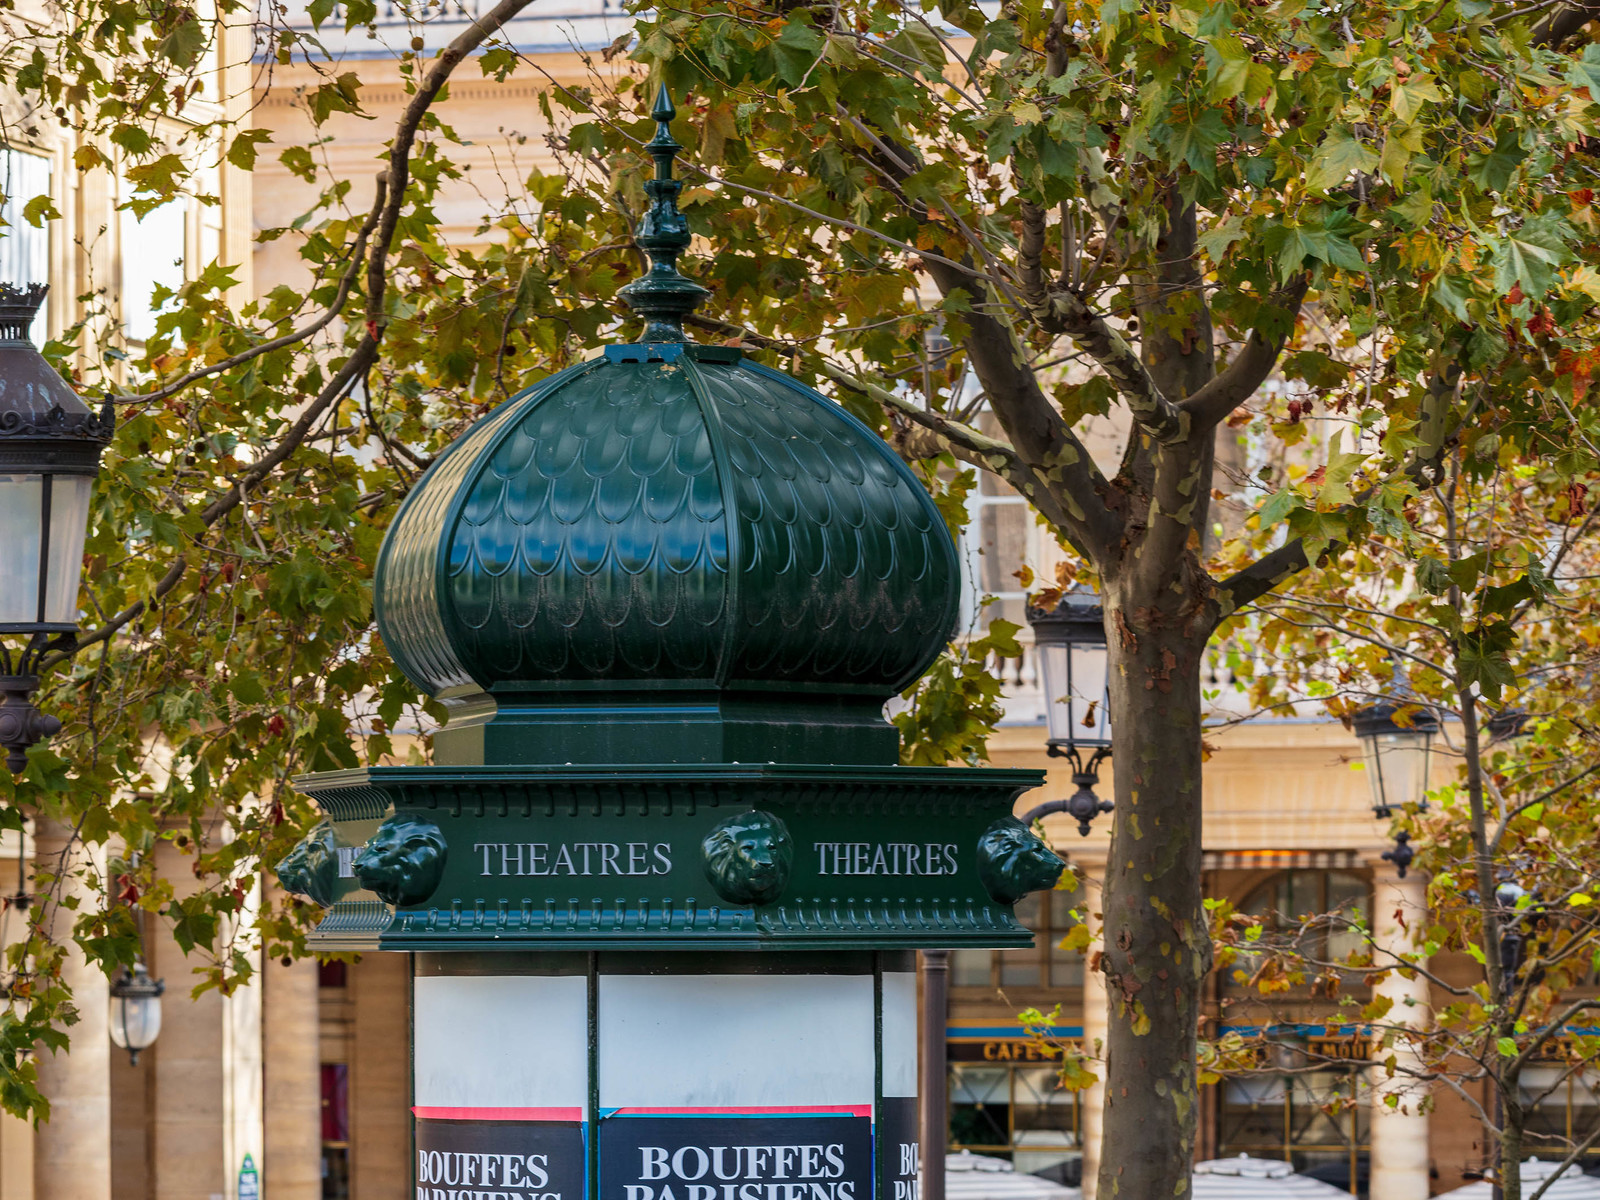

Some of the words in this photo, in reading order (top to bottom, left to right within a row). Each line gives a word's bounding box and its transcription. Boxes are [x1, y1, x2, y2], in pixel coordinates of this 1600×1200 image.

[474, 843, 672, 876] THEATRES
[814, 842, 958, 875] THEATRES
[419, 1150, 548, 1189] BOUFFES
[638, 1144, 845, 1181] BOUFFES
